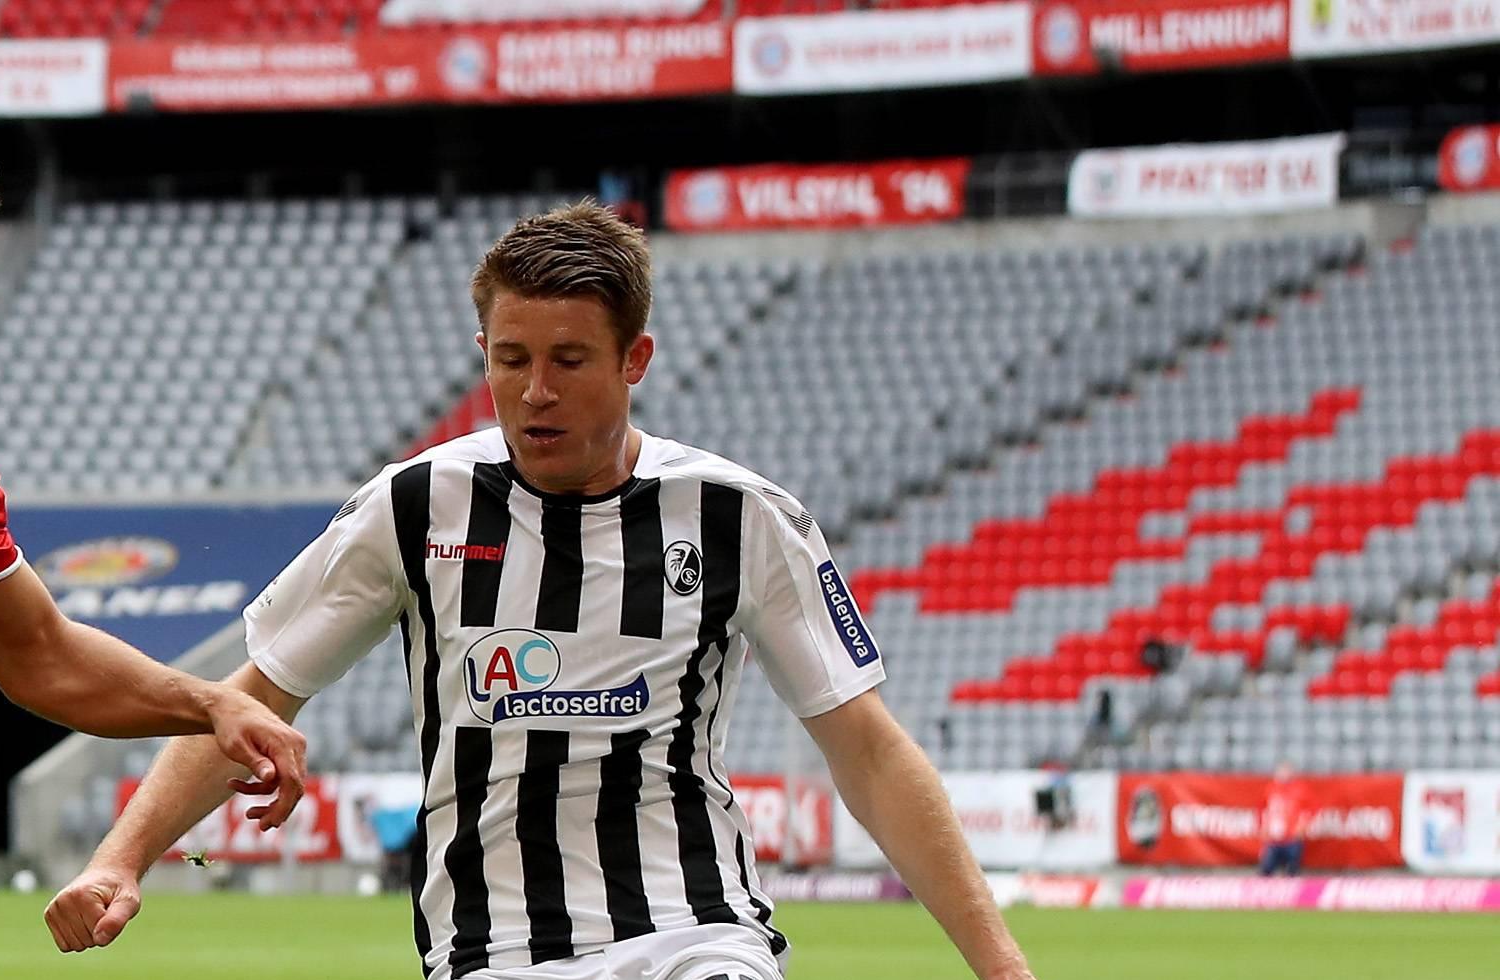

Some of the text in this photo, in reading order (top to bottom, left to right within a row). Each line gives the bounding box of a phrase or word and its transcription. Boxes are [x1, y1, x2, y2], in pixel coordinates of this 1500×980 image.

[1091, 4, 1286, 57] MILLENNIUM
[426, 537, 505, 561] hummel
[821, 567, 870, 660] badenova
[467, 639, 553, 703] LAC
[504, 689, 643, 717] lactosefrei
